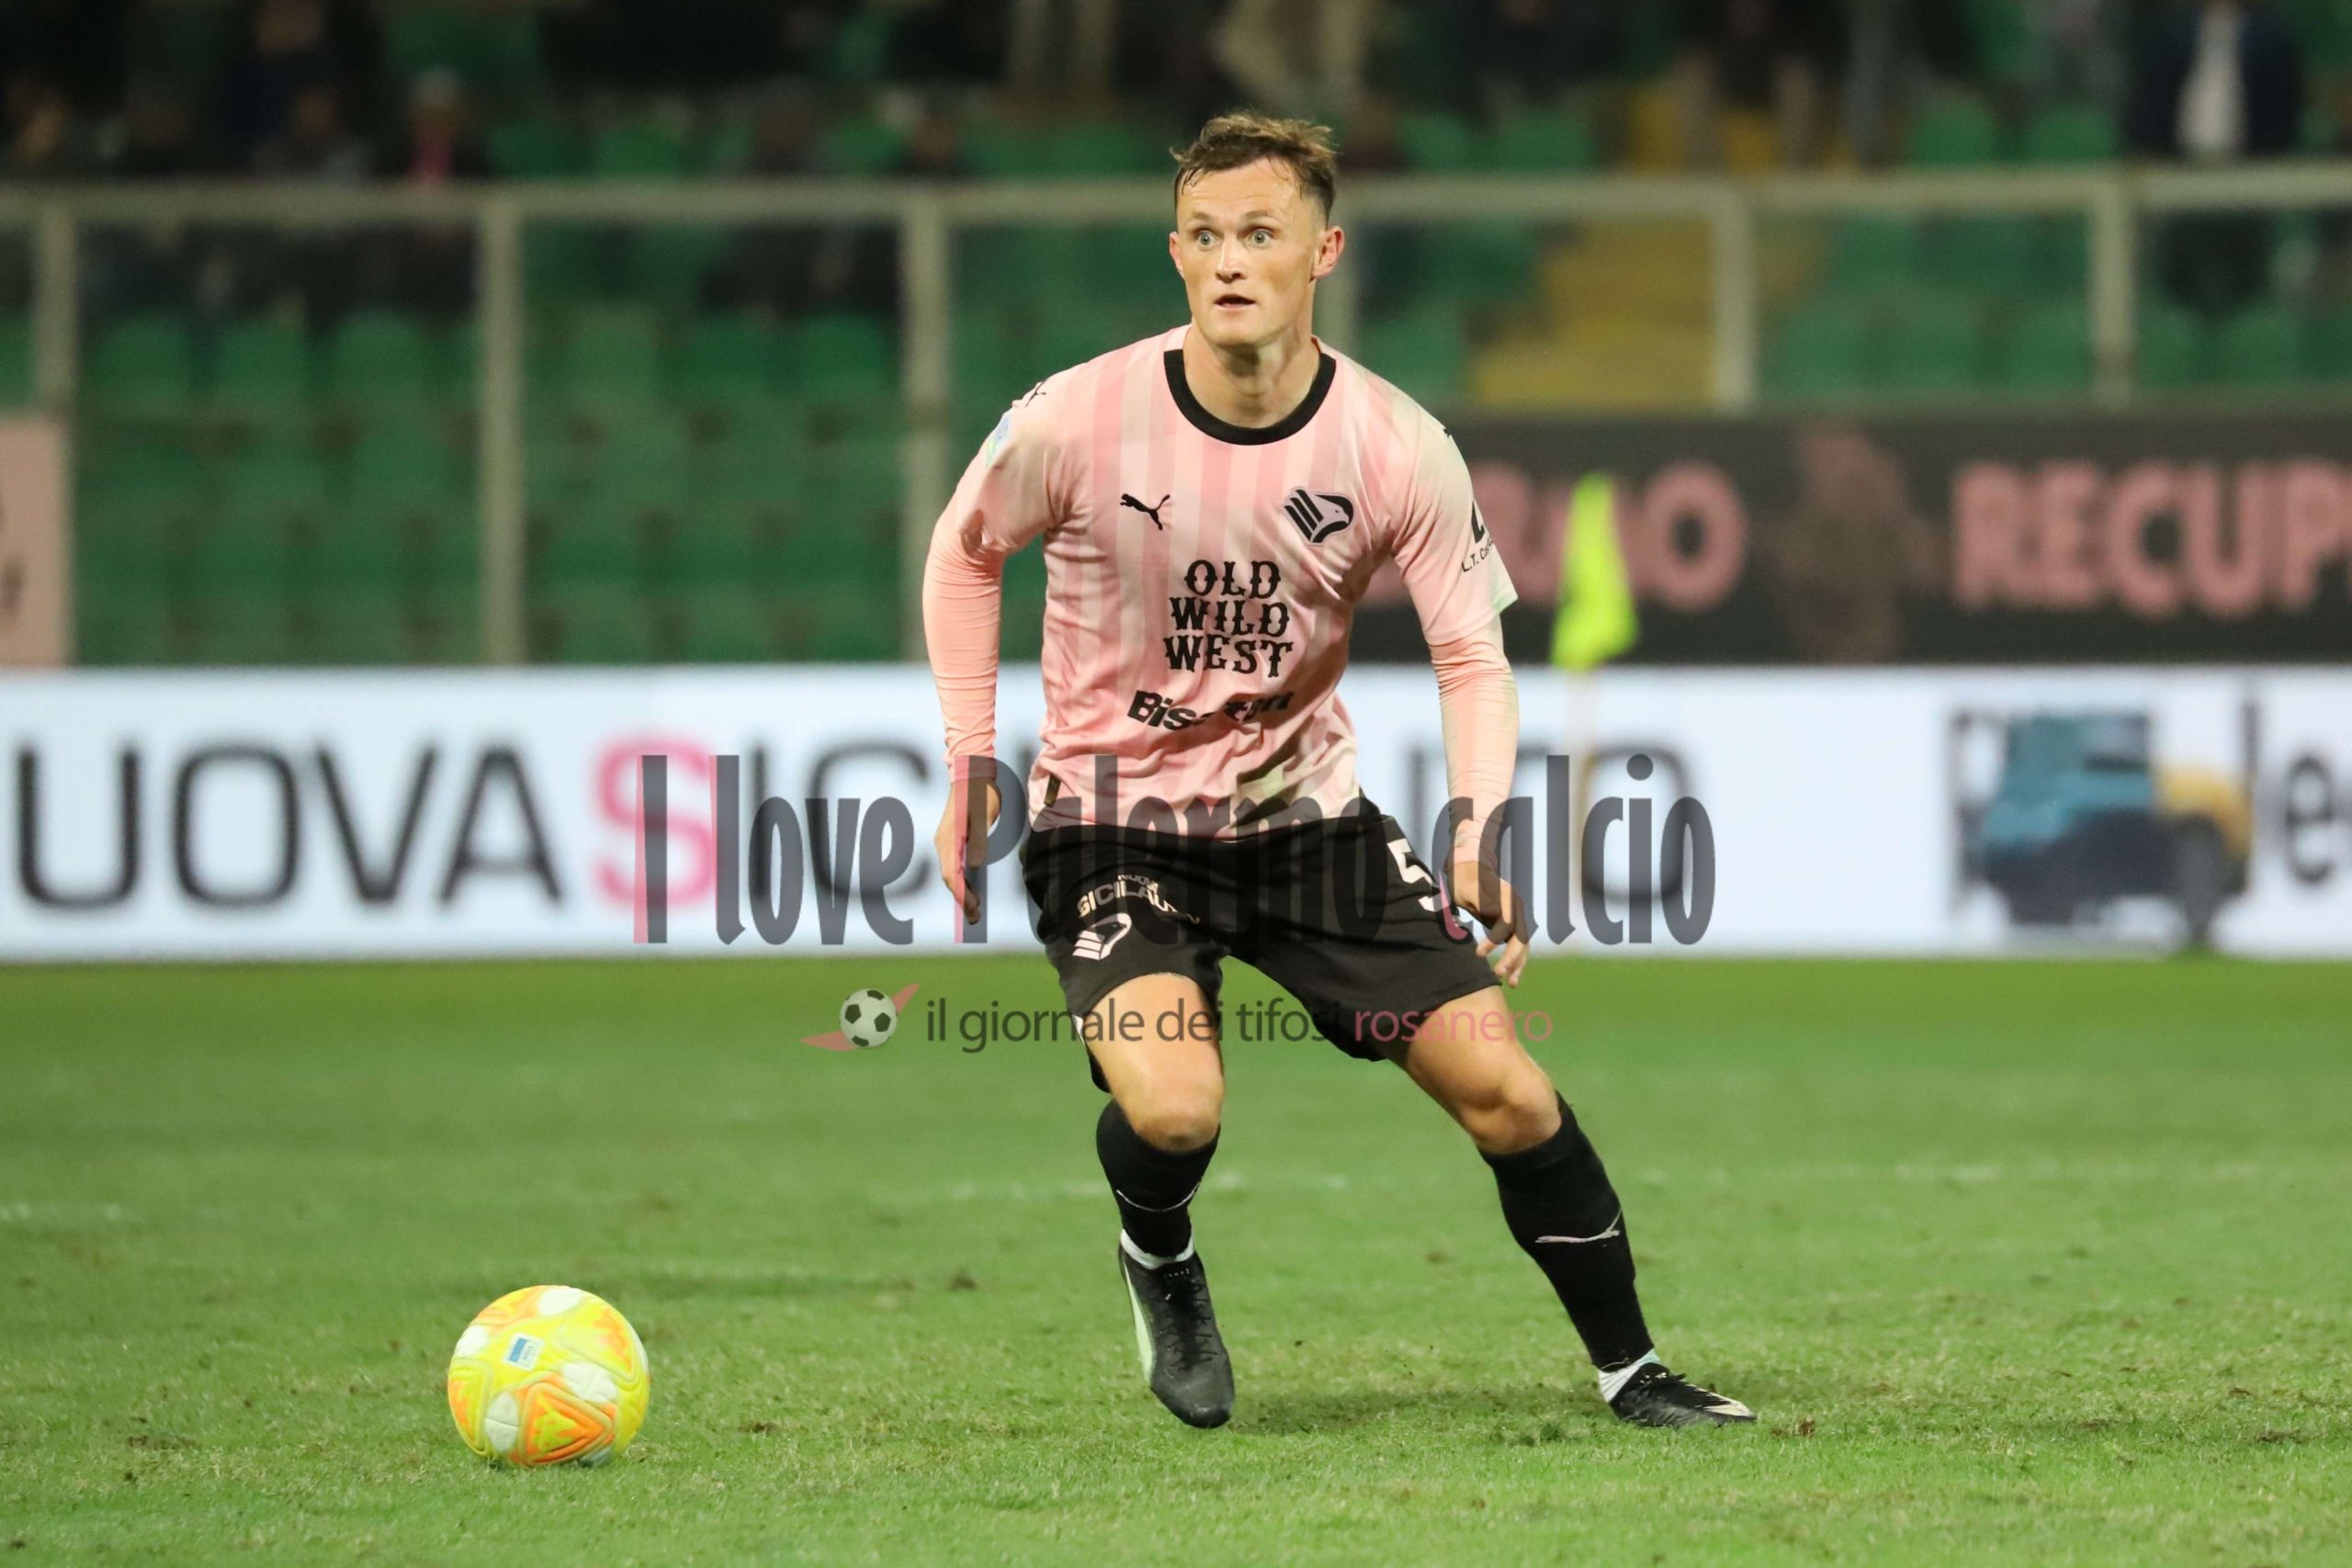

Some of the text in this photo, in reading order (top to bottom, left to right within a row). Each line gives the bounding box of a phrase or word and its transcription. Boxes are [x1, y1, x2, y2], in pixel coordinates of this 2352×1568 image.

[1184, 559, 1281, 598] OLD
[1170, 597, 1290, 637] WILD
[1163, 634, 1294, 678] WEST
[15, 742, 564, 909] UOVA
